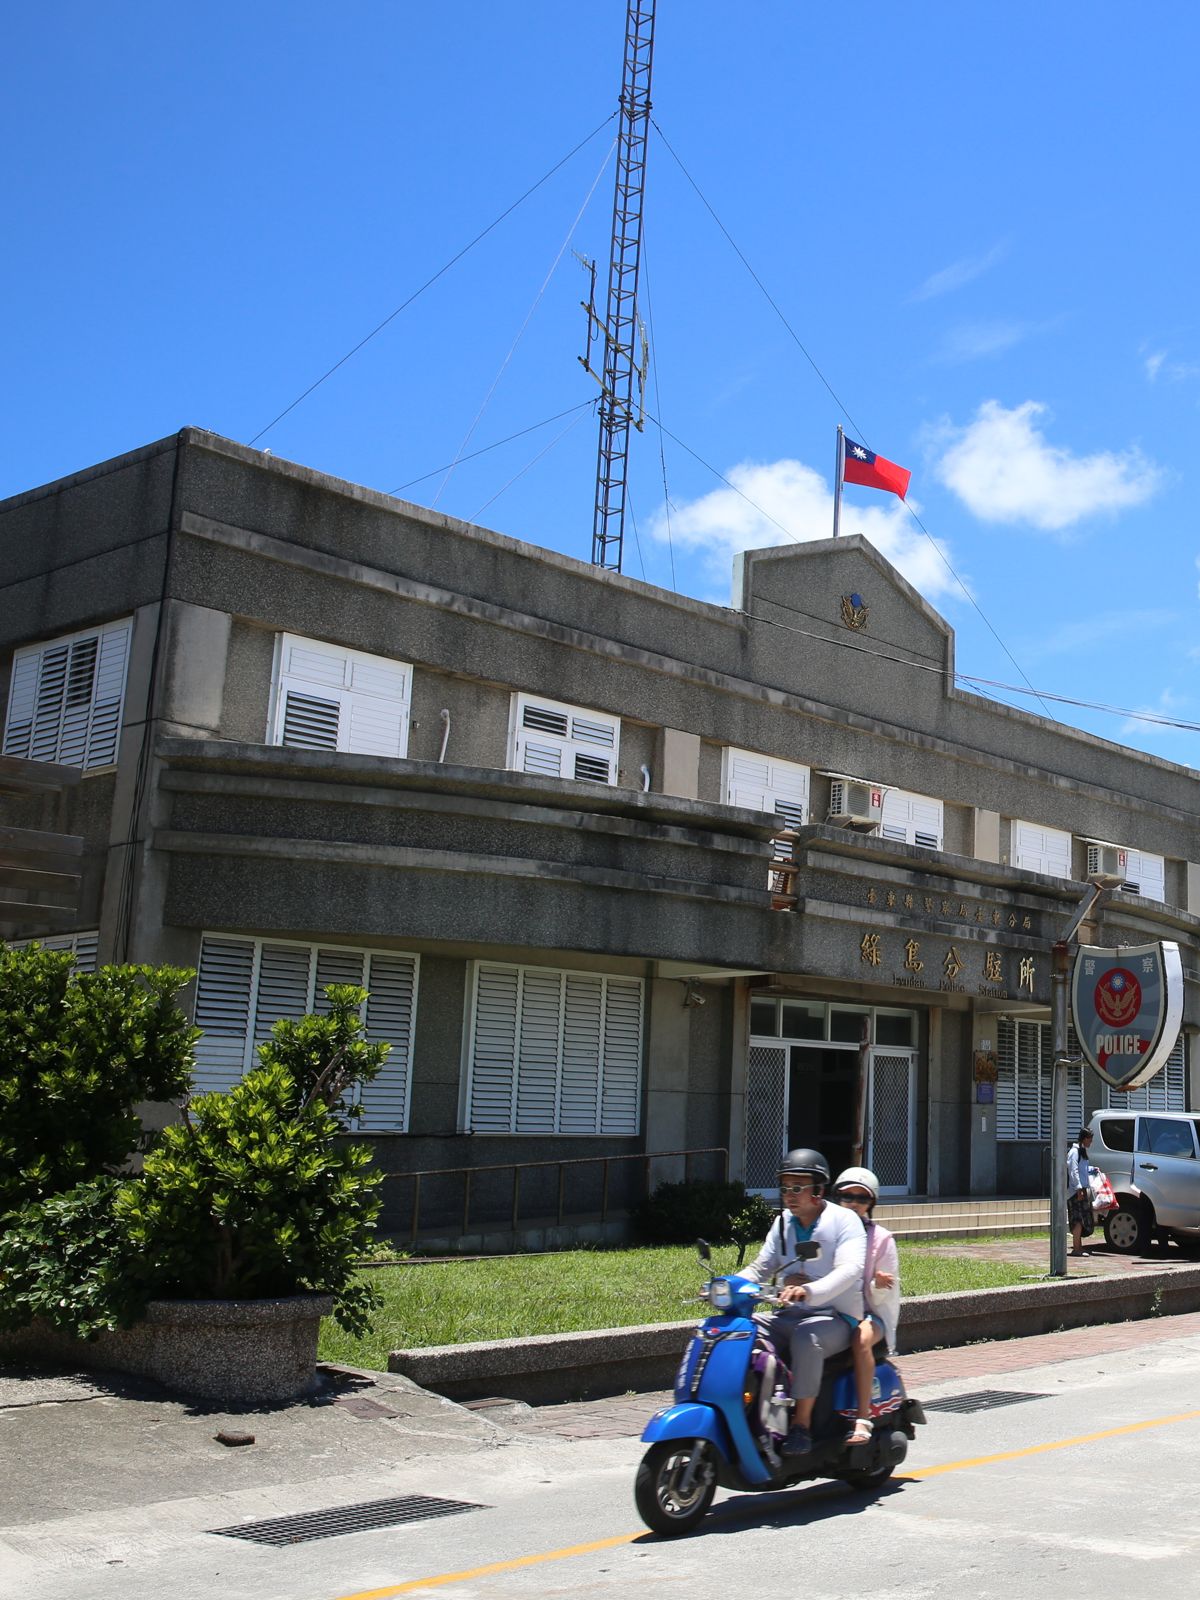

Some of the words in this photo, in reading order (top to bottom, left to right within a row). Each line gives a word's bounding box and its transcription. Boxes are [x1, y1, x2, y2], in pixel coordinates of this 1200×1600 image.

[861, 934, 1035, 993] 綠島分駐所
[1096, 1034, 1140, 1054] POLICE
